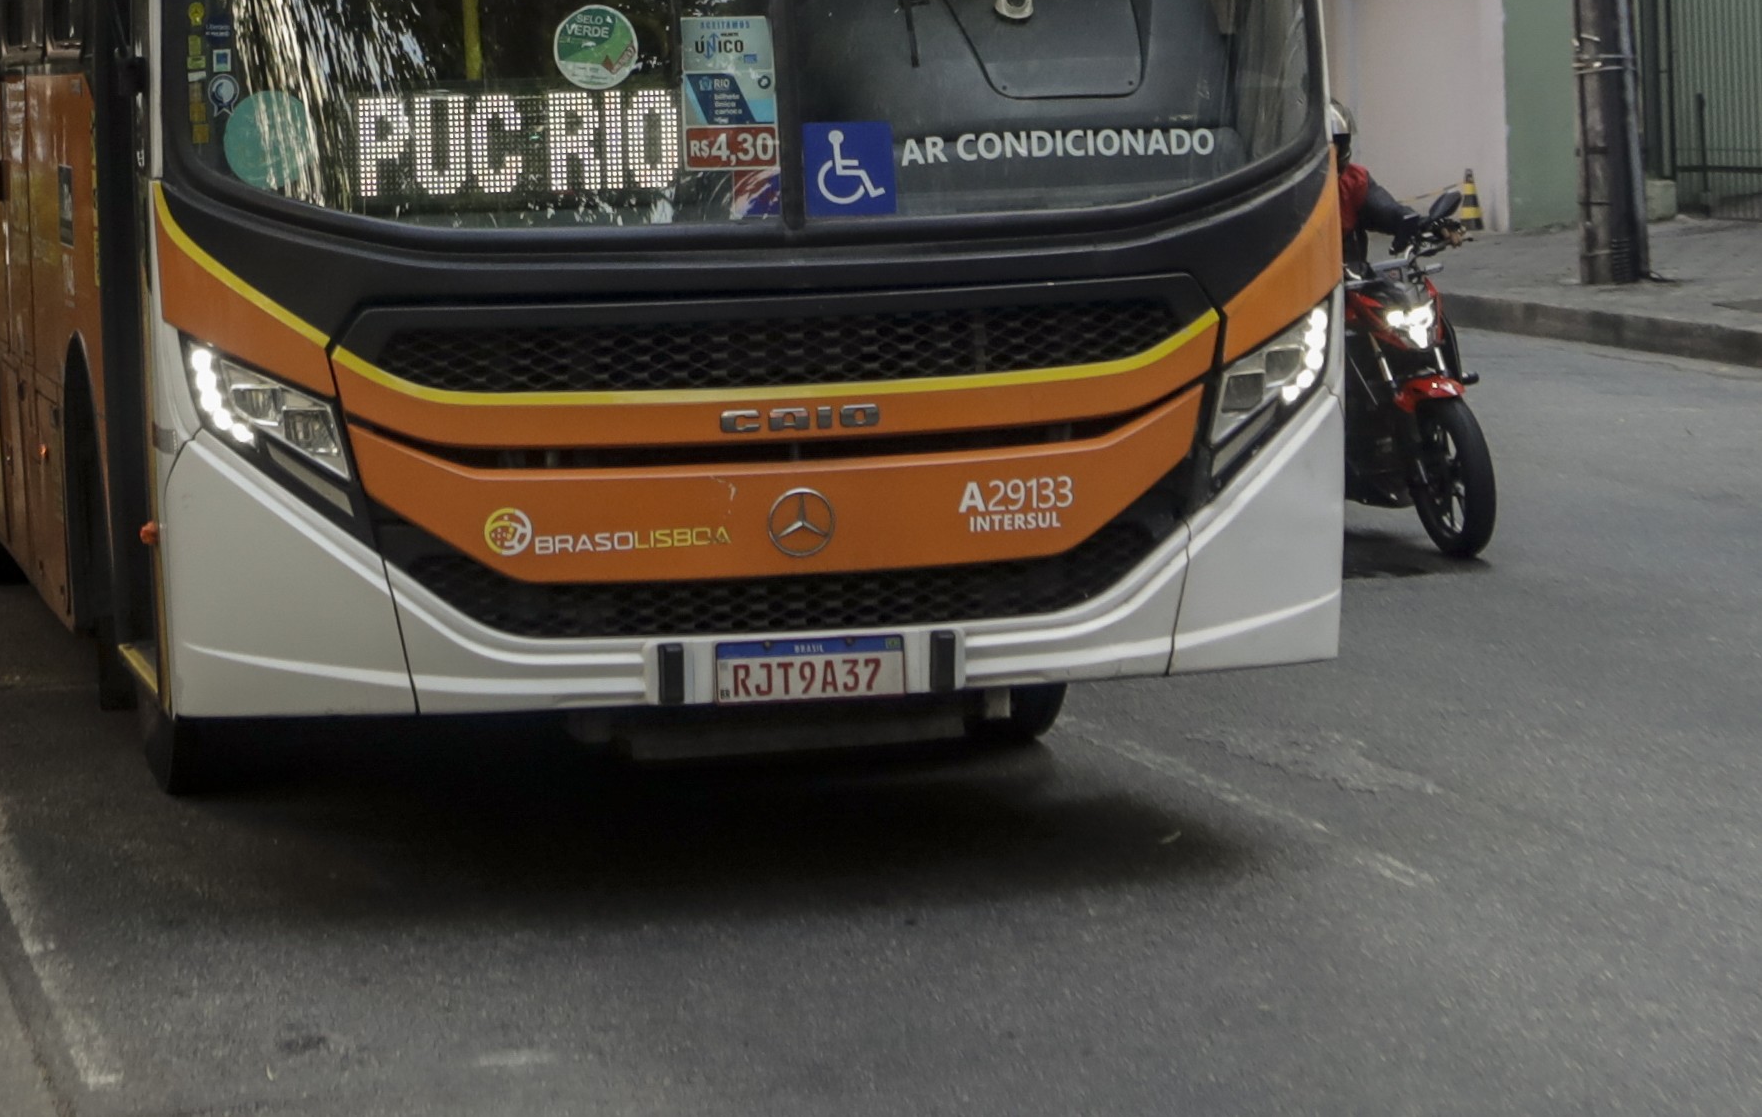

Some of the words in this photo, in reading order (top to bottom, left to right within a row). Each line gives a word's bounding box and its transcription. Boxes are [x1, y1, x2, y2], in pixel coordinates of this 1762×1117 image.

[575, 13, 604, 25] SELO
[565, 23, 610, 39] VERDE
[695, 33, 745, 57] ÚNICO
[713, 78, 730, 89] RIO
[357, 94, 523, 197] PUC
[547, 89, 680, 192] RIO
[900, 137, 946, 166] AR
[956, 128, 1216, 160] CONDICIONADO
[958, 475, 1074, 514] A29133
[969, 511, 1061, 533] INTERSUL
[794, 643, 825, 654] BRASIL
[732, 657, 882, 698] RJT9A37
